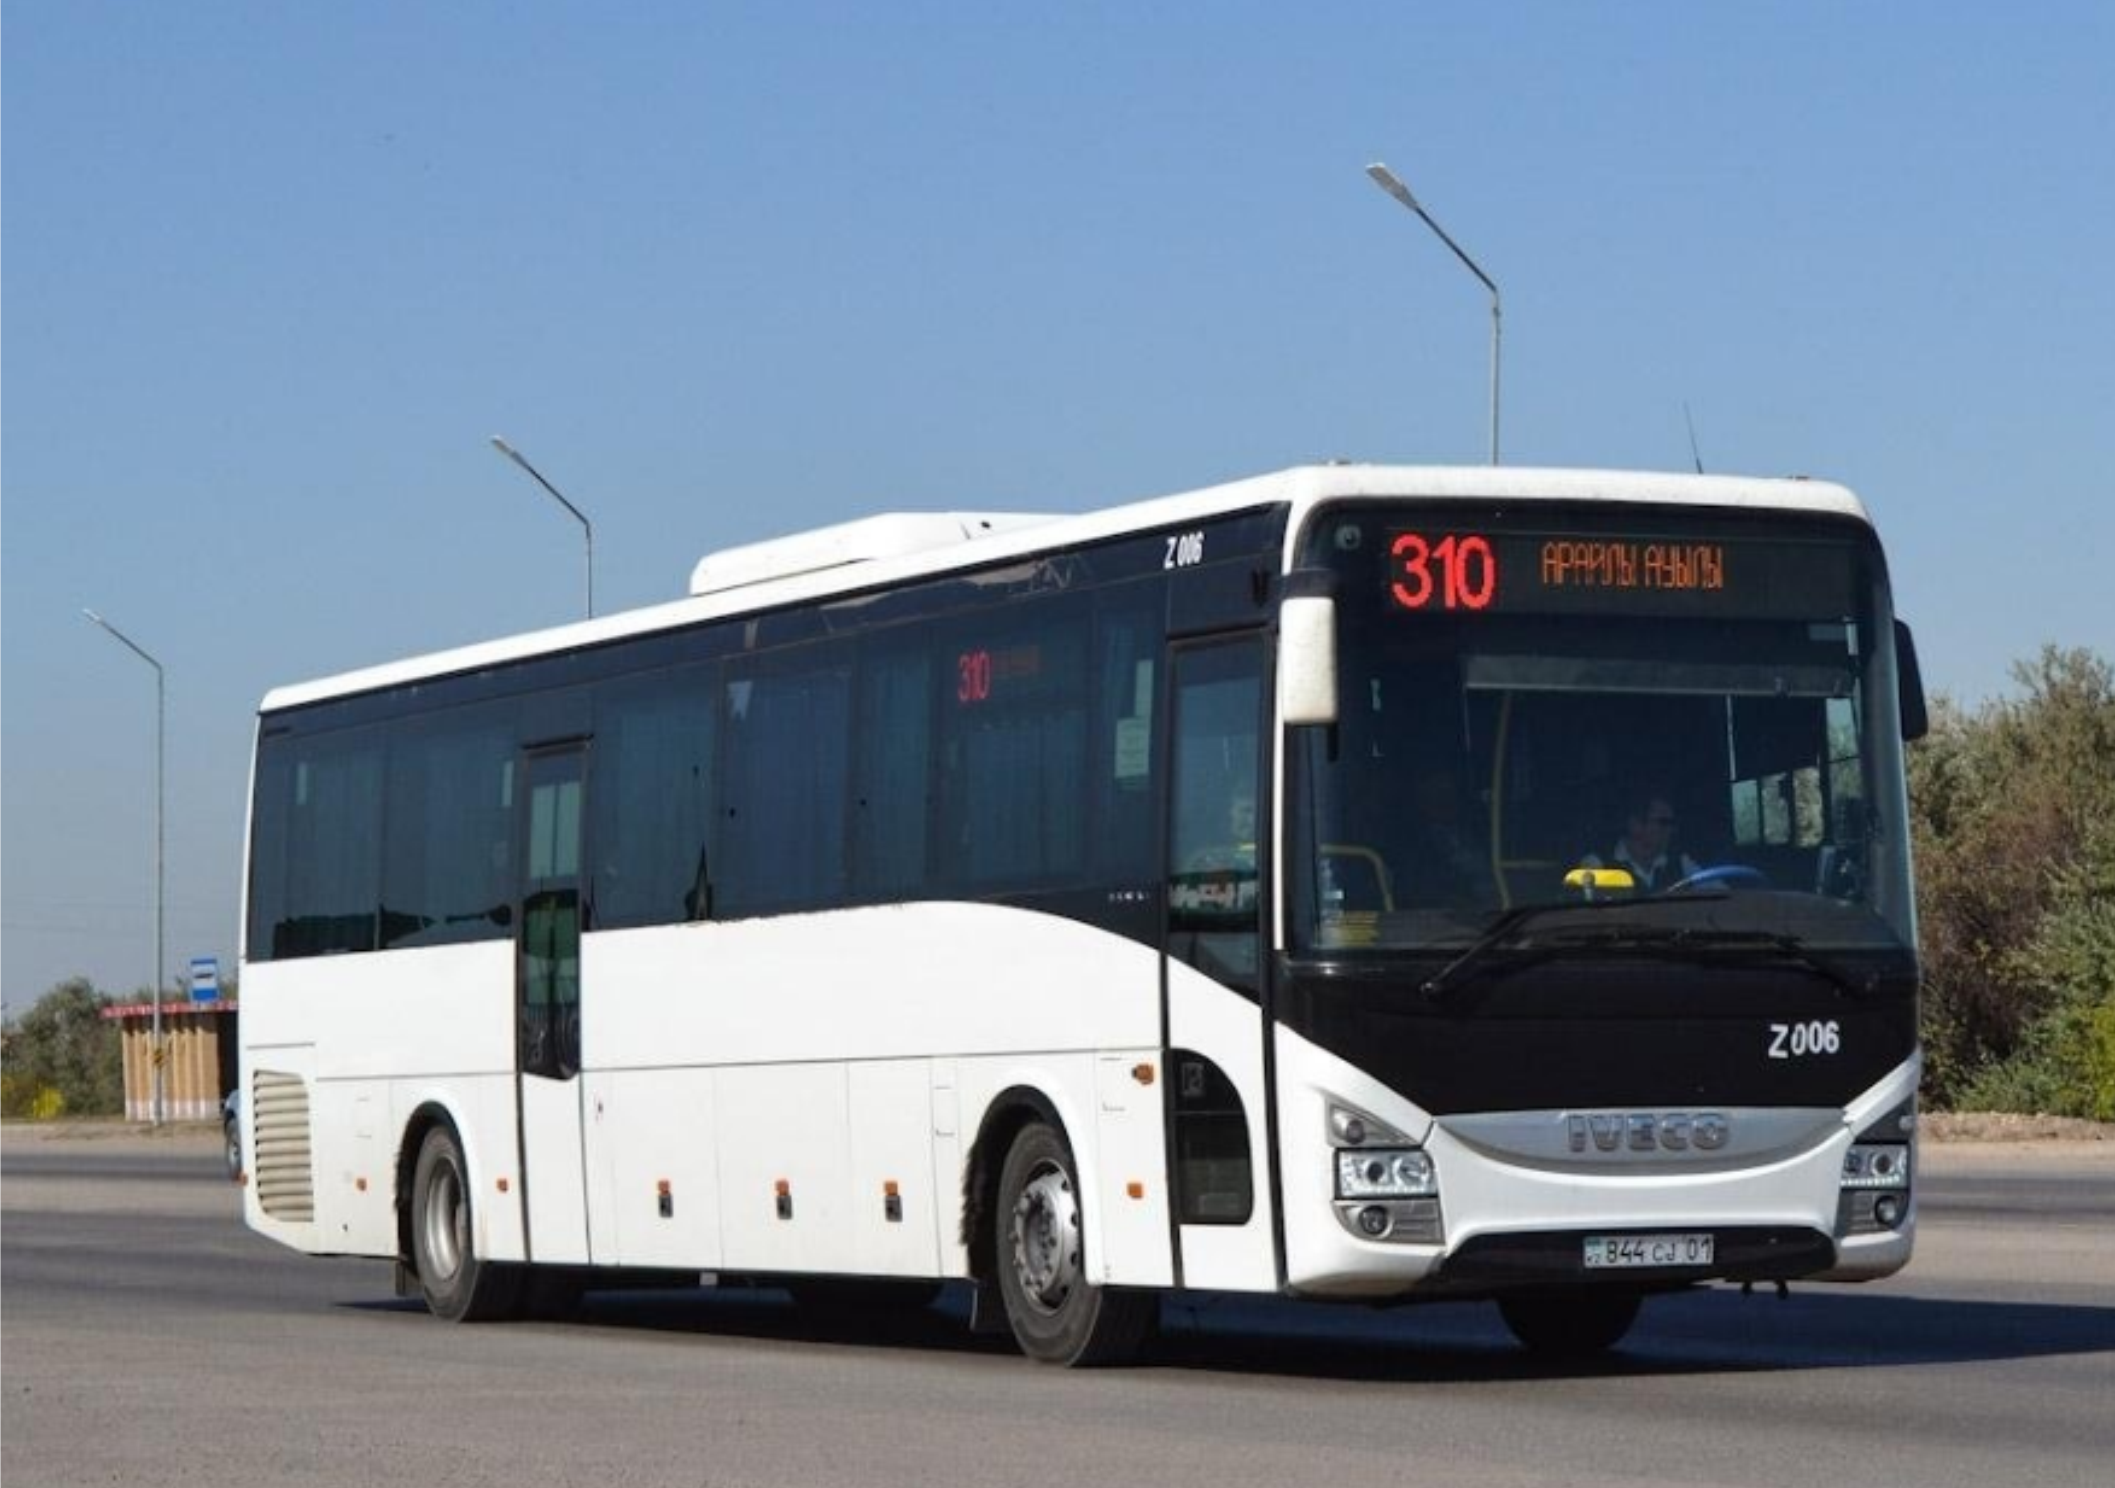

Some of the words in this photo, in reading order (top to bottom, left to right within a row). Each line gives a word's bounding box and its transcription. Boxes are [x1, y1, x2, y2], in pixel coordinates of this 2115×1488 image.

[1390, 533, 1496, 609] 310
[957, 650, 992, 702] 310
[1567, 1112, 1729, 1152] IVECO
[1606, 1239, 1645, 1264] 844
[1686, 1236, 1710, 1262] 01
